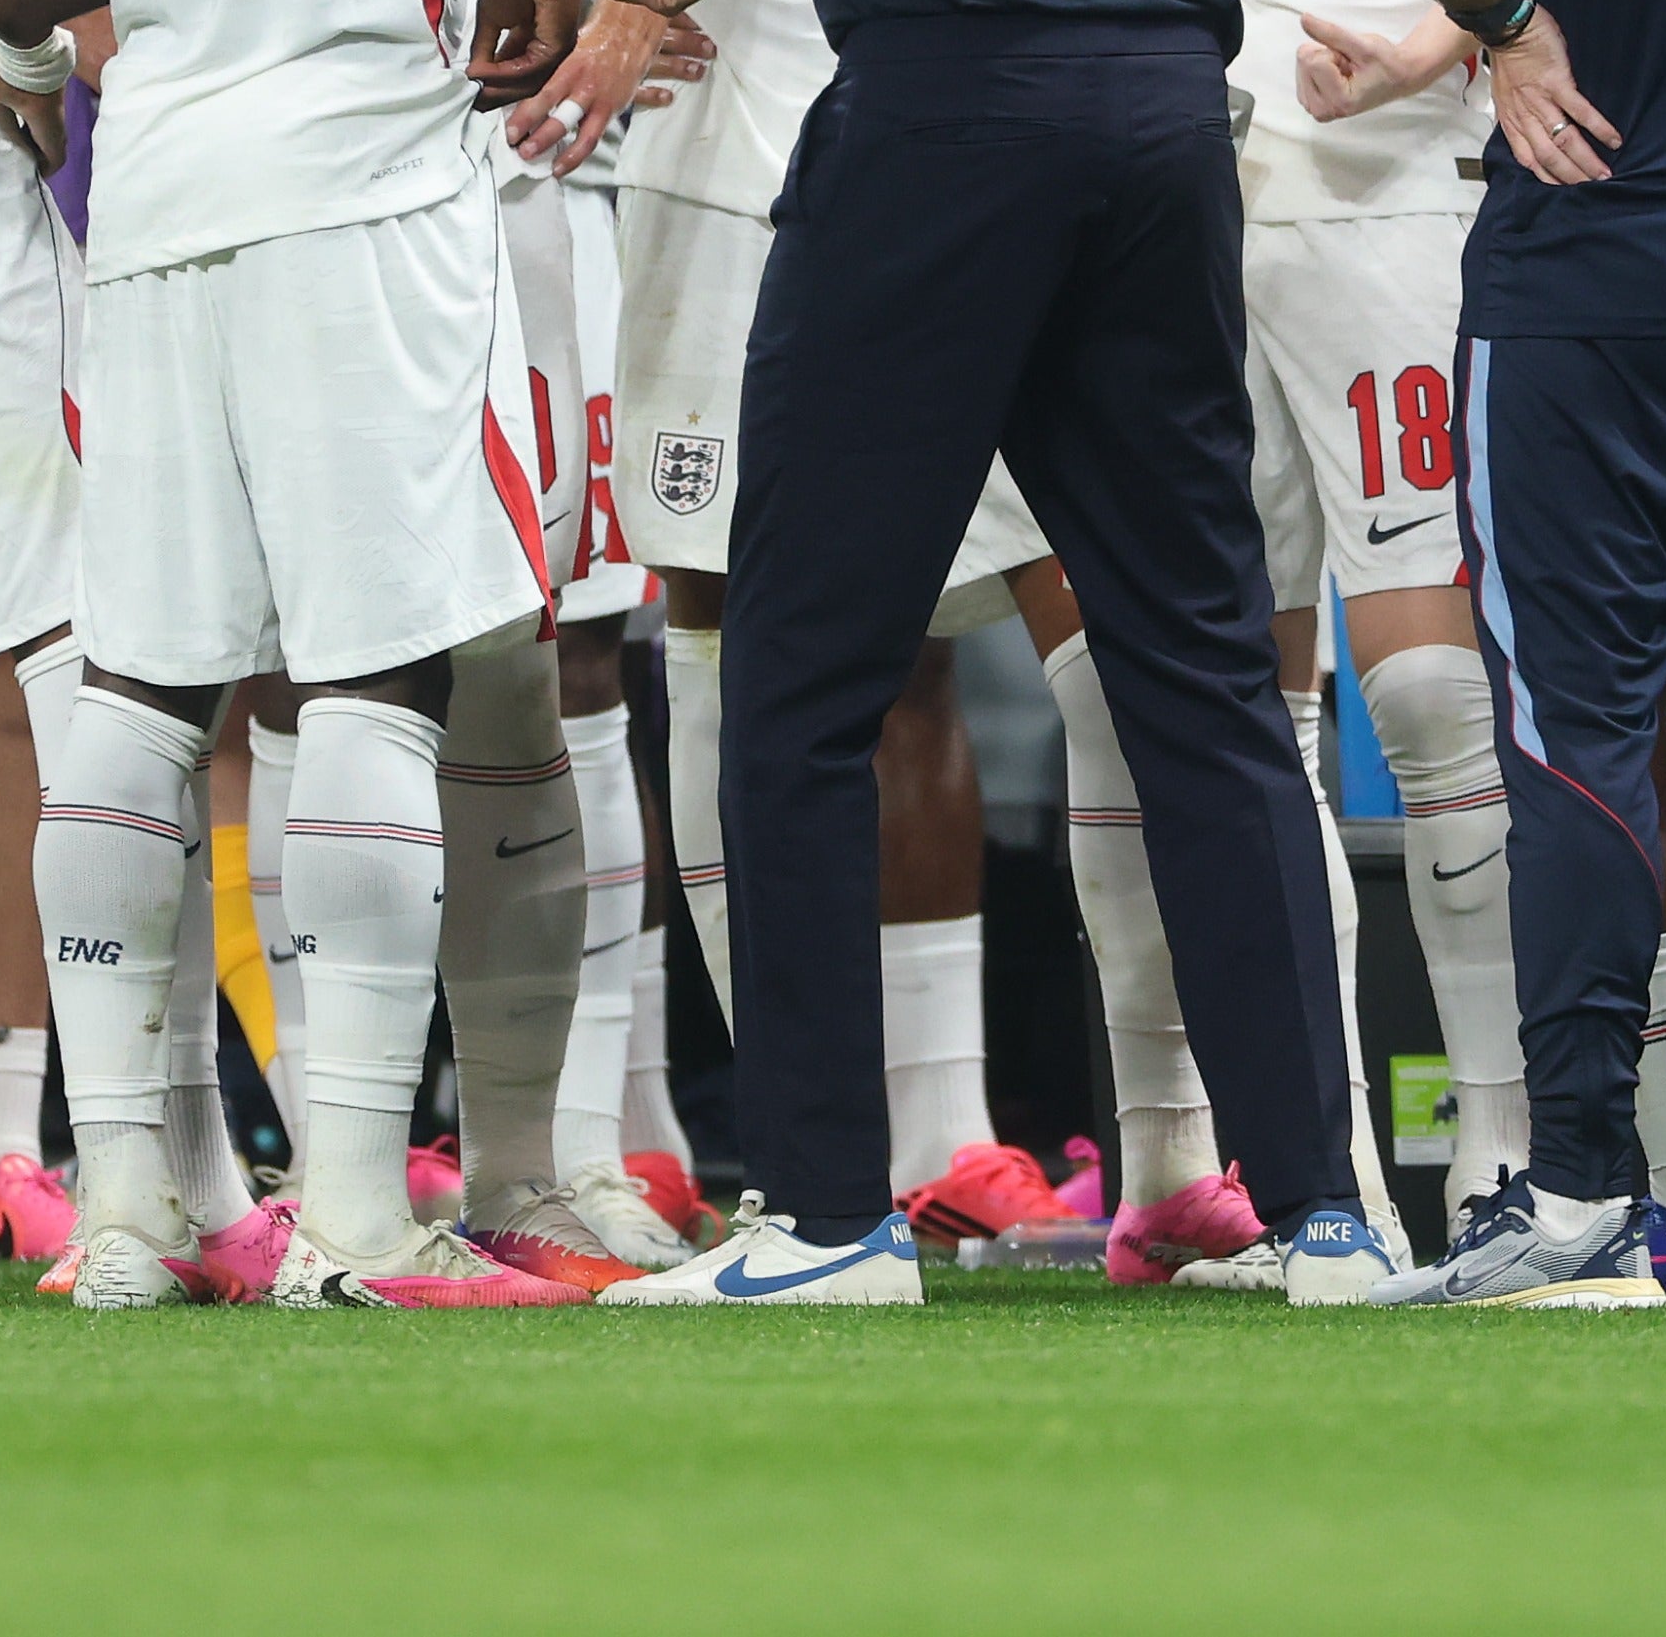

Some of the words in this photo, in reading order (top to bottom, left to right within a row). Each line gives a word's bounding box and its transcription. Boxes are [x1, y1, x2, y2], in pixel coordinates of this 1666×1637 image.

[1346, 364, 1455, 500] 18
[58, 935, 124, 966] ENG
[1306, 1222, 1352, 1244] NIKE
